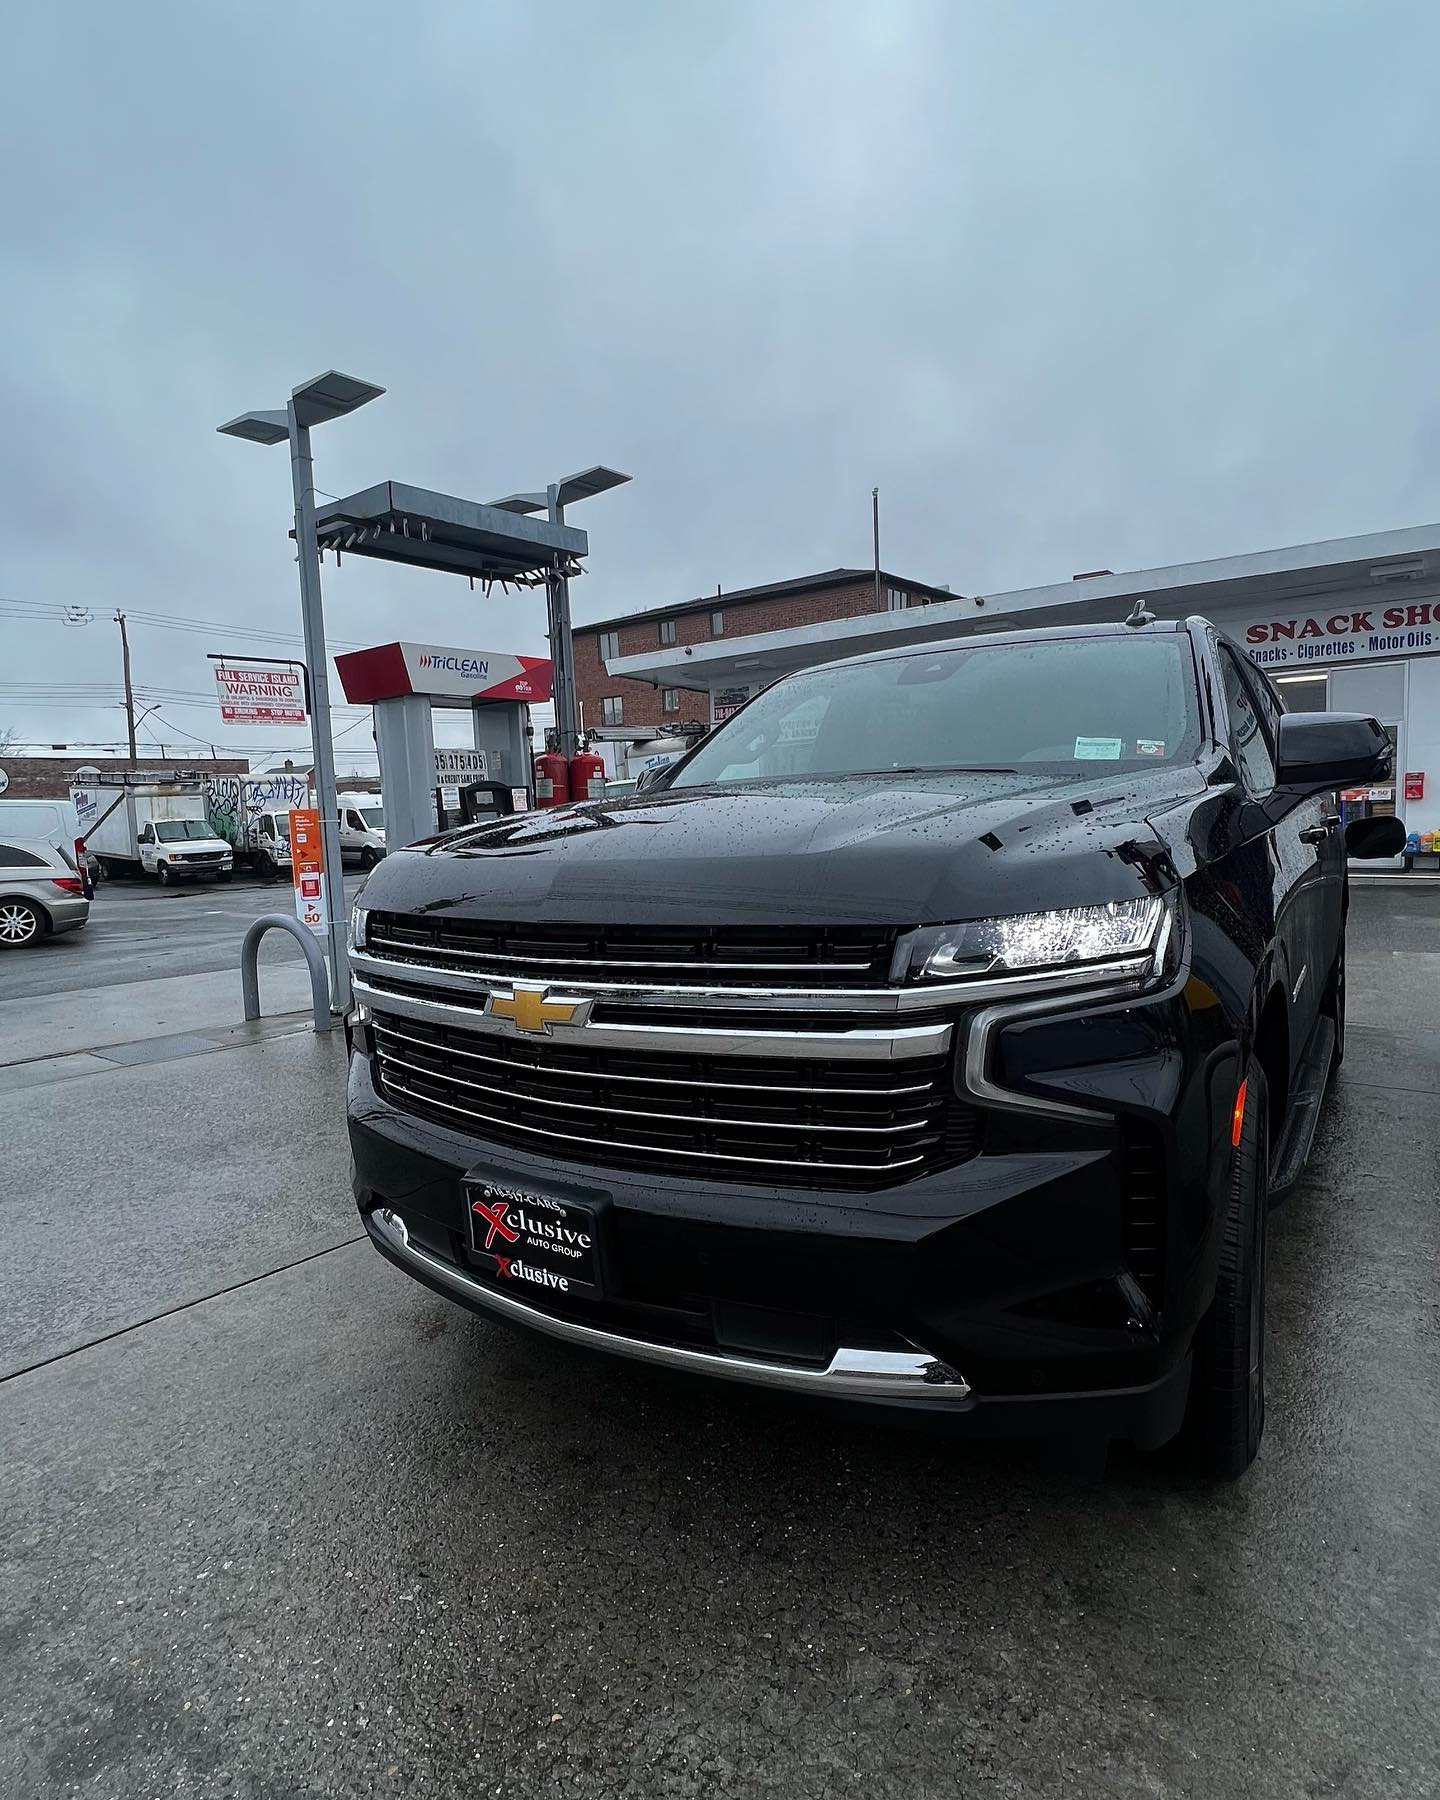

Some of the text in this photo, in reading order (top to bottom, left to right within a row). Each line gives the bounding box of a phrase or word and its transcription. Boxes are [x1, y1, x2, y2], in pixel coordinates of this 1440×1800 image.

[1246, 611, 1375, 644] SNACK
[1249, 631, 1432, 663] Snacks Cigarettes Motor Oils
[431, 655, 489, 674] TriCLEAN
[460, 671, 487, 680] Gasoline
[218, 670, 297, 685] FULL SERVICE ISLAND
[225, 682, 293, 697] WARNING
[472, 1201, 592, 1249] Xclusive
[526, 1236, 583, 1259] AUTO GROUP
[495, 1253, 569, 1291] Xclusive
